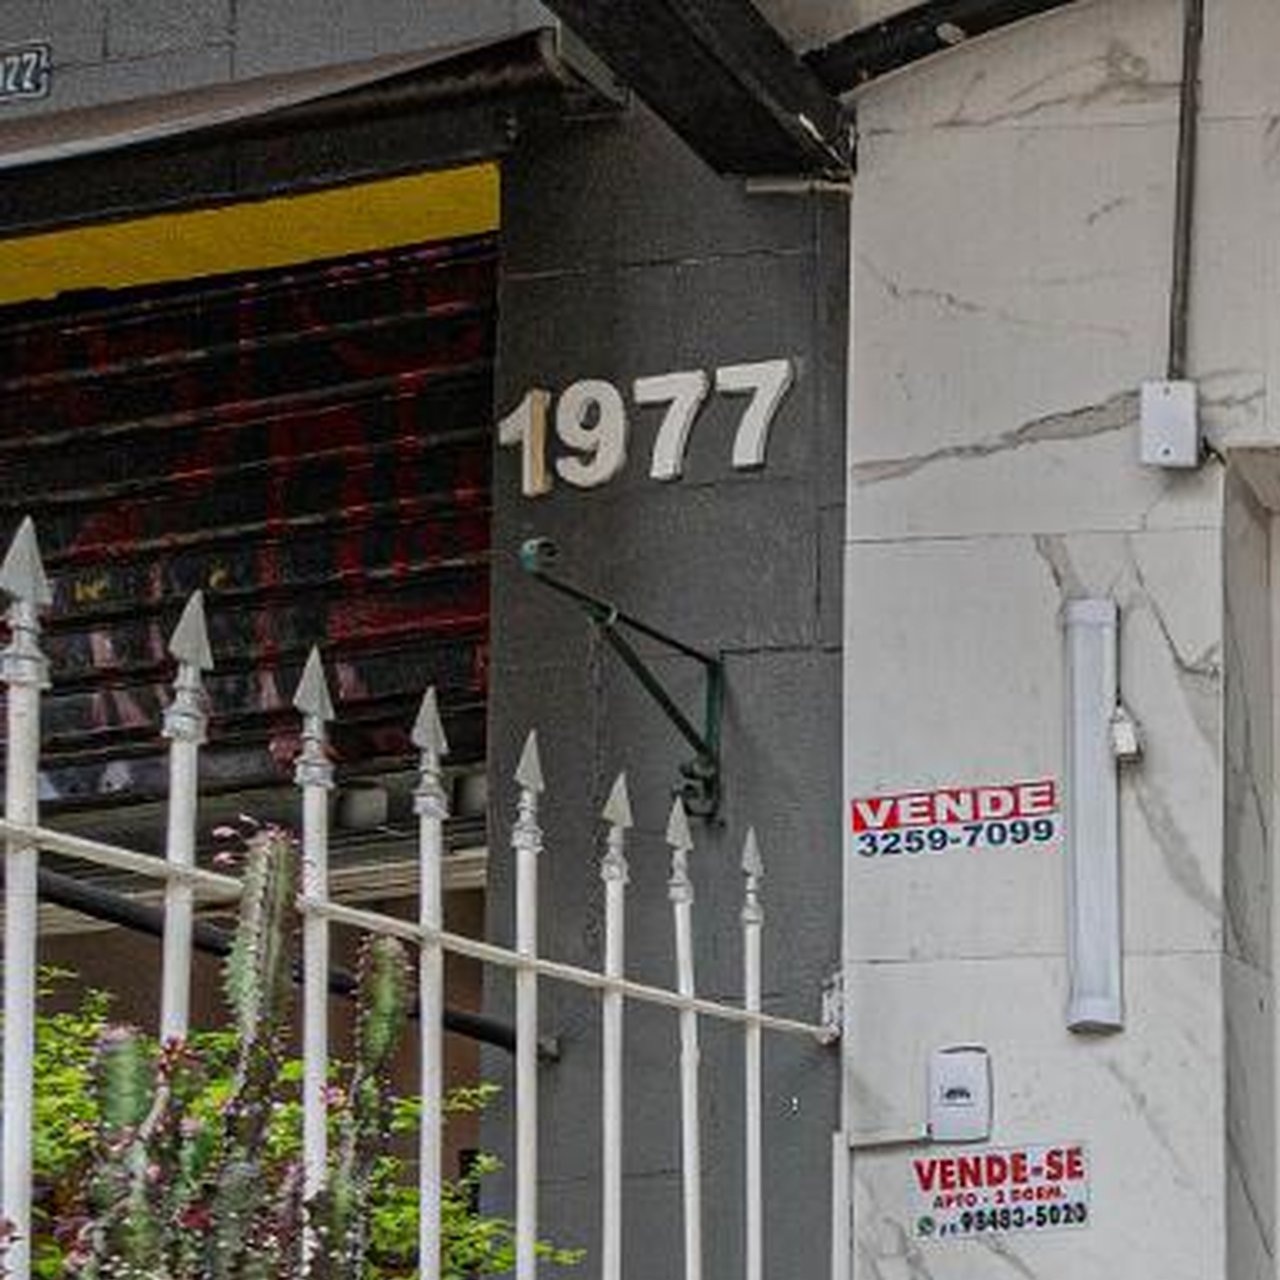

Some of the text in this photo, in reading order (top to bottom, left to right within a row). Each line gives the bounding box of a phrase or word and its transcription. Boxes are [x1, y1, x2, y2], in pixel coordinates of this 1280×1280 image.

[499, 359, 792, 496] 1977
[854, 785, 1053, 828] VENDE
[857, 820, 1054, 857] 3259-7099
[913, 1147, 1084, 1191] VENDE-SE
